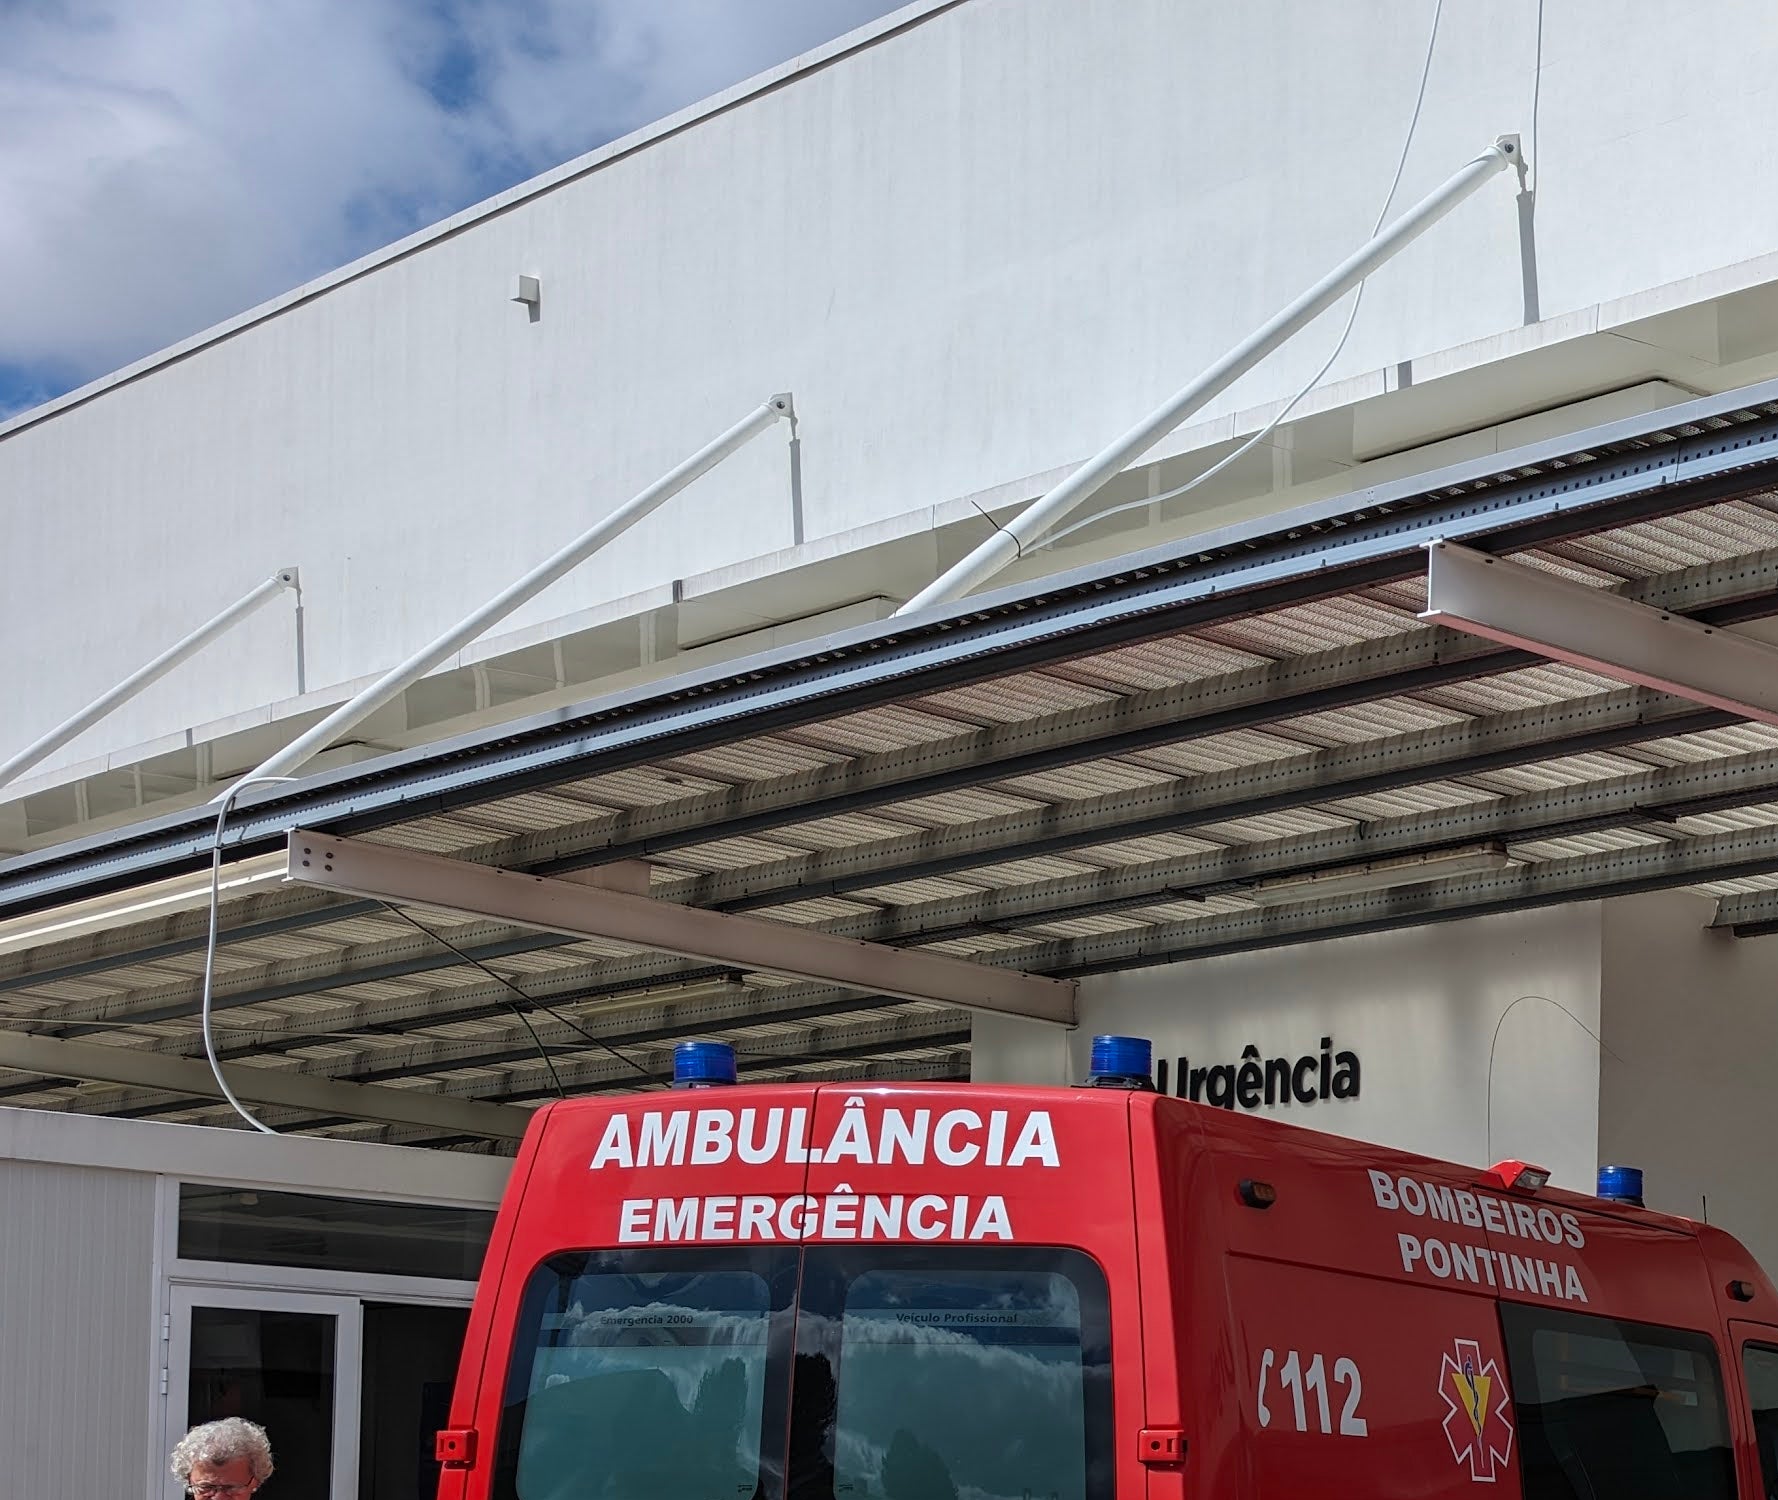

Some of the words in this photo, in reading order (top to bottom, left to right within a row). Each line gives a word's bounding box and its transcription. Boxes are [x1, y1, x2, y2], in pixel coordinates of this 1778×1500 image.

[1157, 1036, 1361, 1110] Urgência
[589, 1096, 1061, 1170] AMBULÂNCIA
[618, 1183, 1014, 1242] EMERGÊNCIA
[1367, 1168, 1585, 1249] BOMBEIROS
[1397, 1233, 1589, 1303] PONTINHA
[666, 1315, 693, 1324] 2000
[896, 1313, 940, 1323] Veículo
[944, 1313, 1018, 1323] Profissional
[1280, 1350, 1368, 1437] 112
